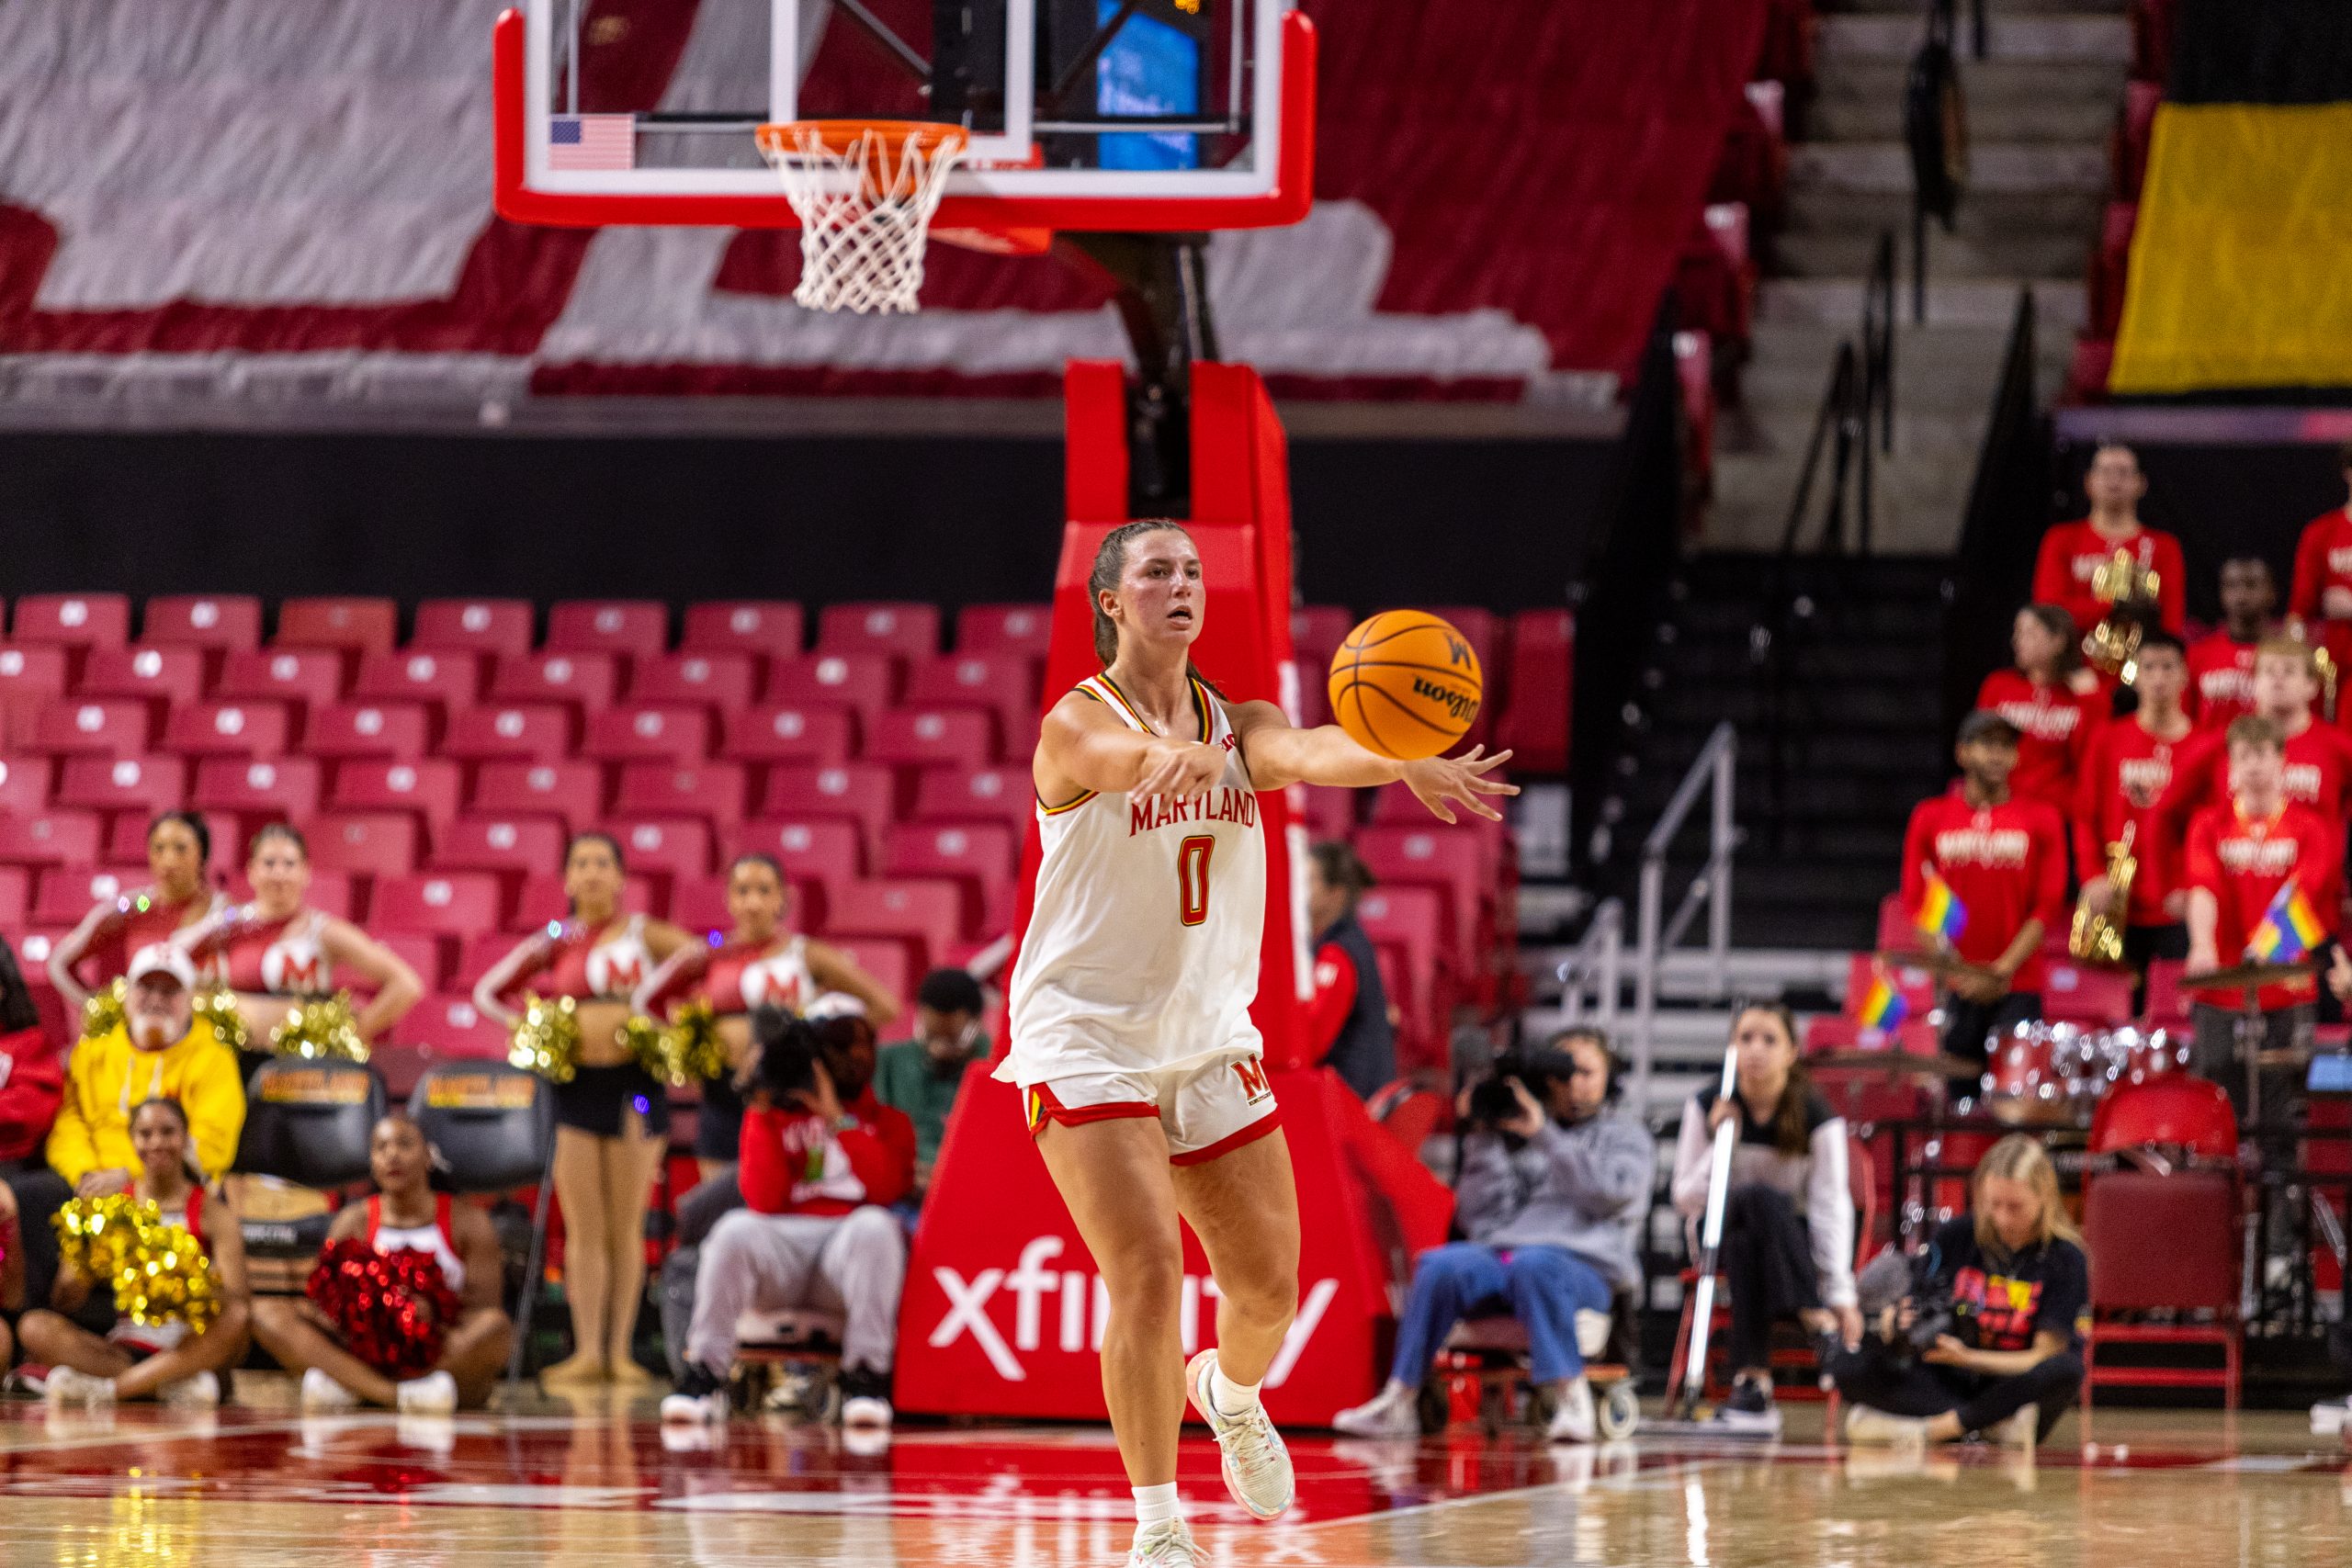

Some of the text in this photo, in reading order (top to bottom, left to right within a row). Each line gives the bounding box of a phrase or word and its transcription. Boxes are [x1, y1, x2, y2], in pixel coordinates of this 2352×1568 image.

[1129, 786, 1256, 838] MARYLAND
[1178, 834, 1216, 928] 0
[1229, 1053, 1270, 1100] M
